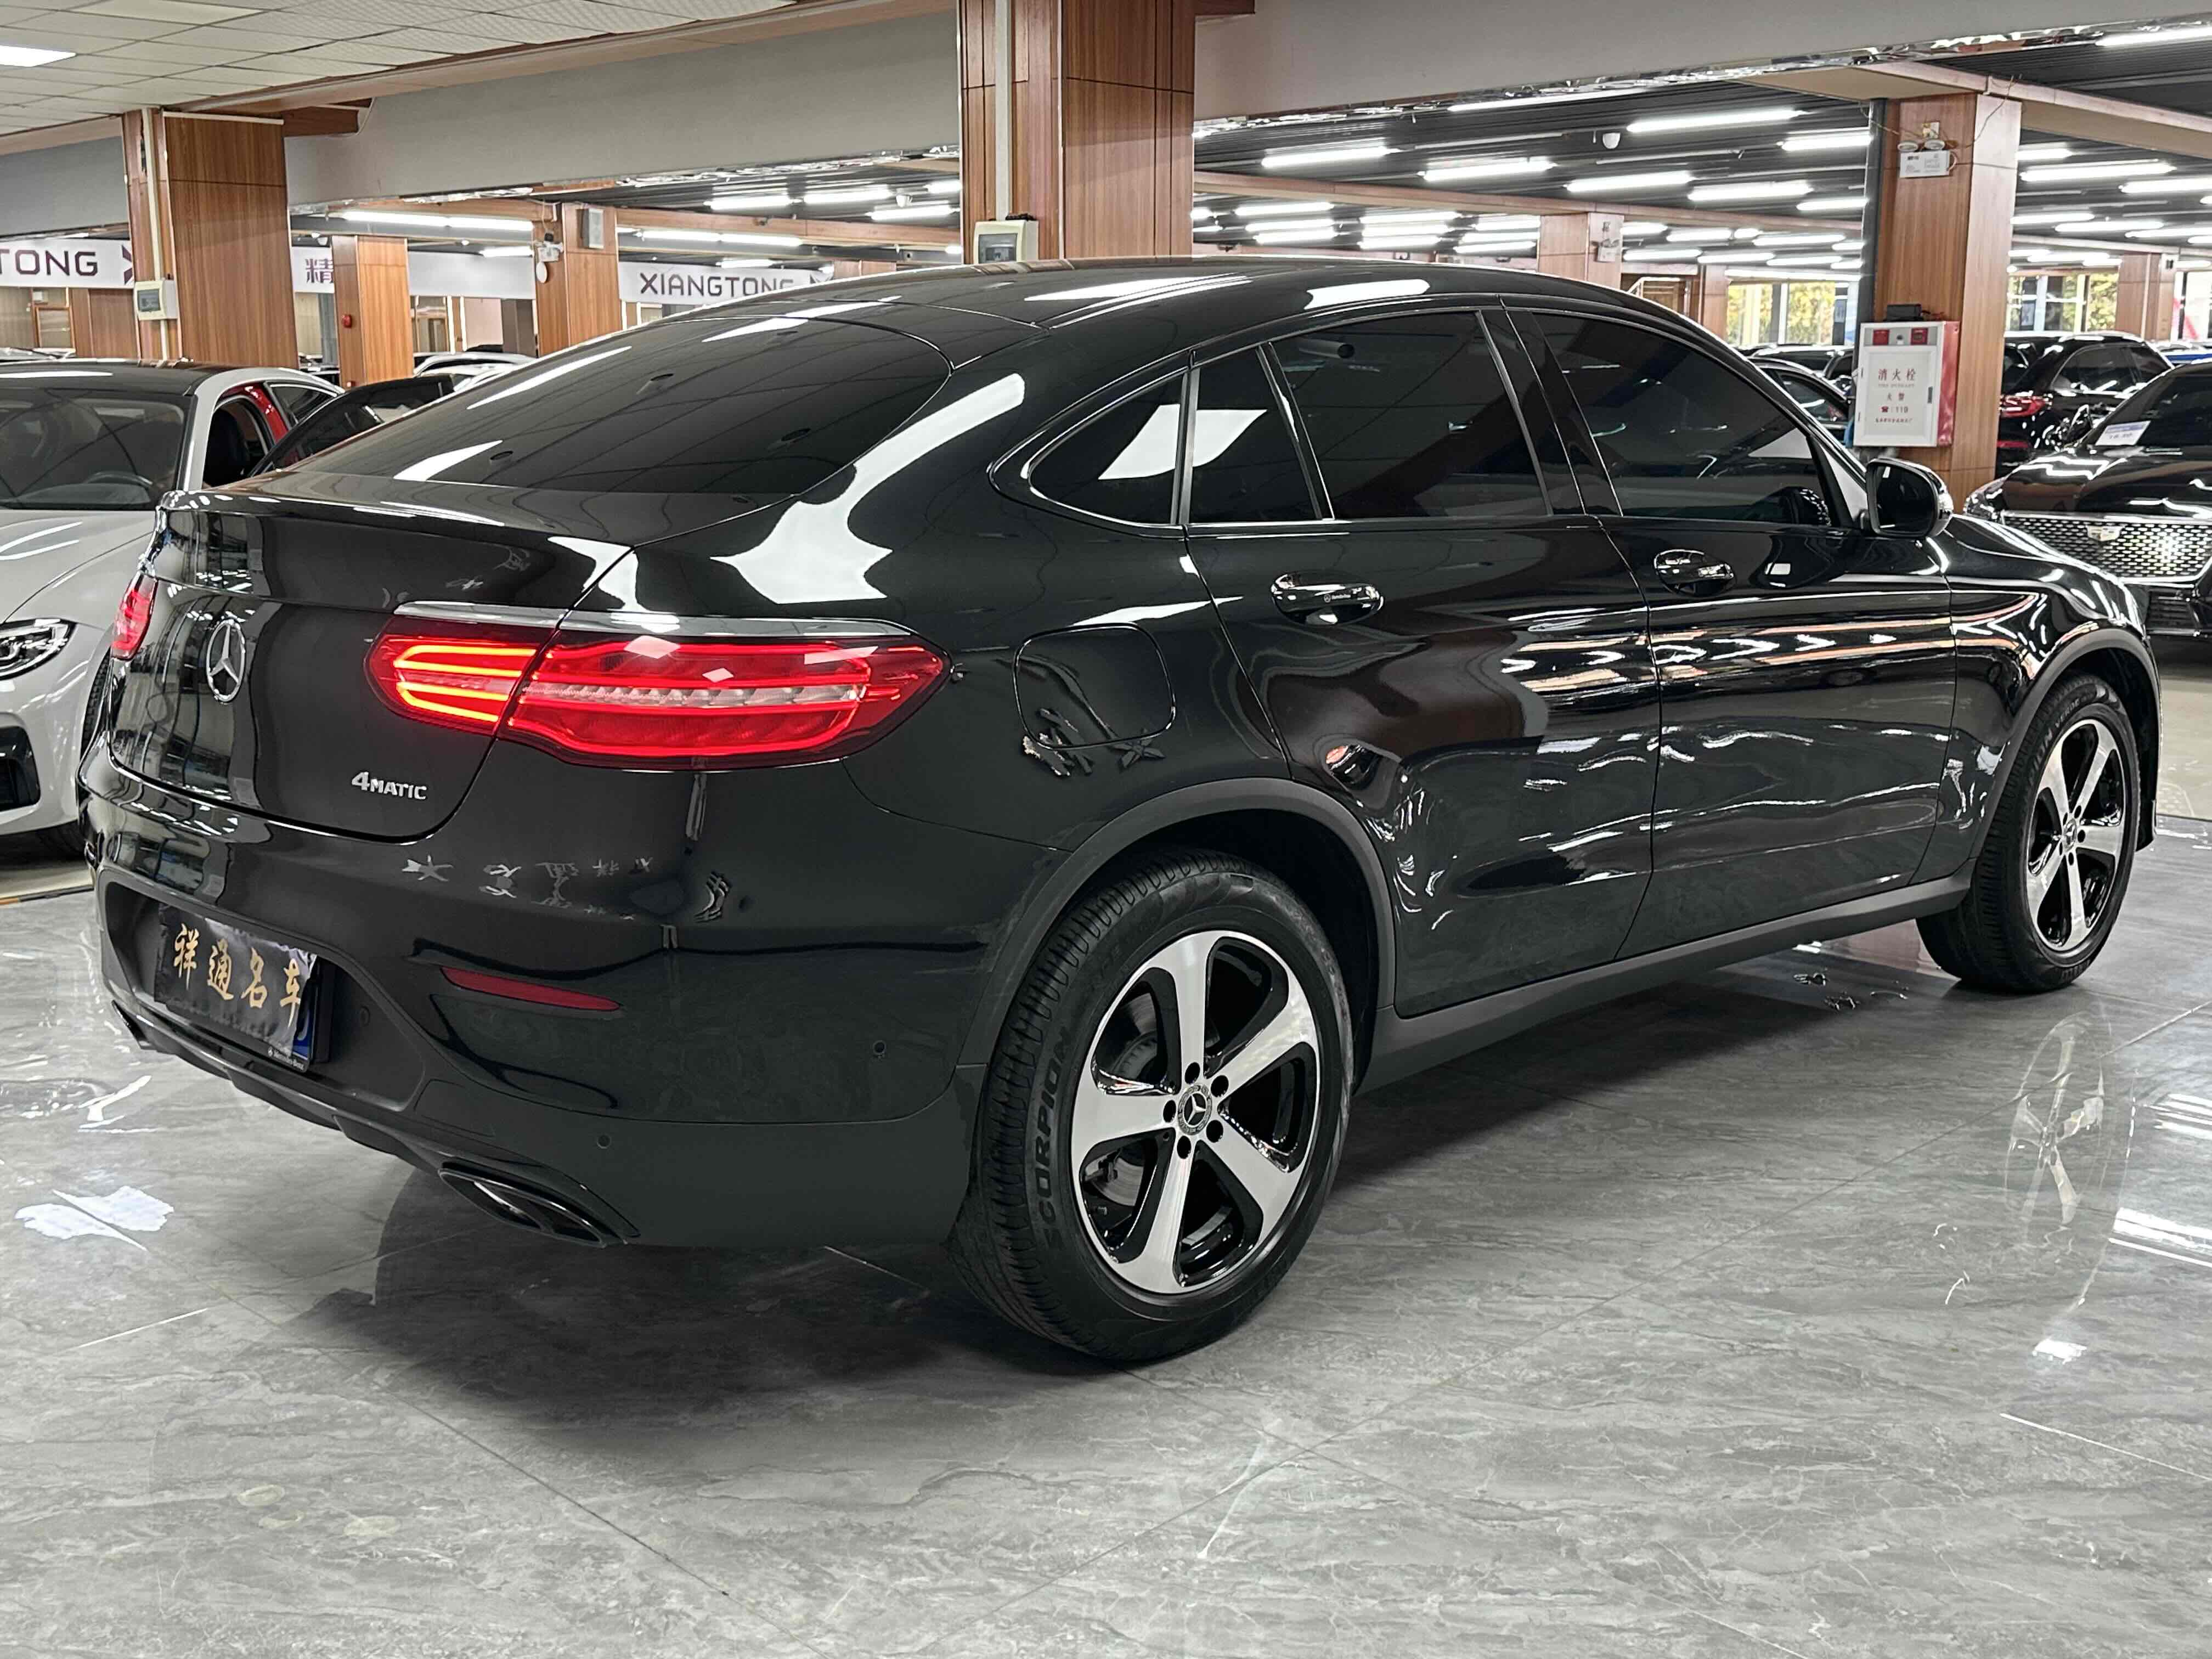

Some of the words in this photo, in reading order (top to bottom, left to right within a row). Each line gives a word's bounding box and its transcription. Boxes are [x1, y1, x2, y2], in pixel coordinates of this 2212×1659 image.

[305, 258, 333, 283] 精
[1878, 368, 1916, 381] 消火栓
[352, 771, 427, 800] 4MATIC
[1035, 1025, 1070, 1251] SCORPION
